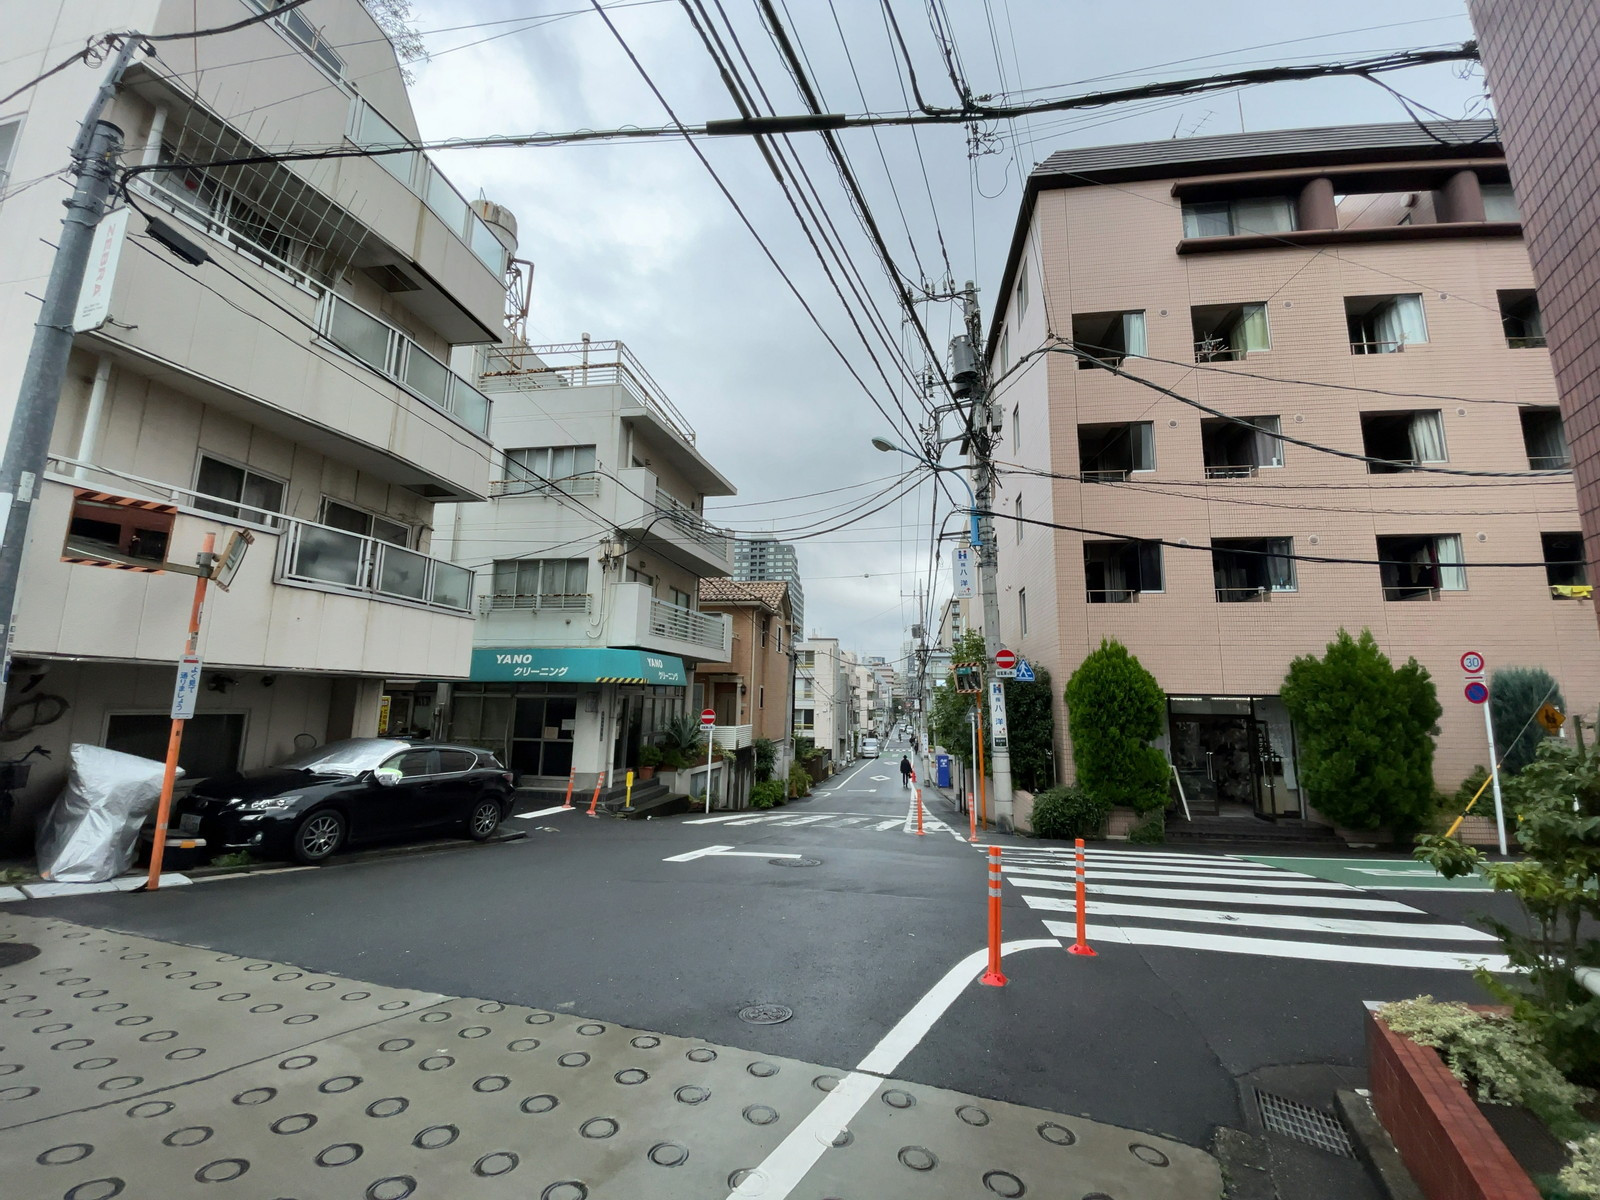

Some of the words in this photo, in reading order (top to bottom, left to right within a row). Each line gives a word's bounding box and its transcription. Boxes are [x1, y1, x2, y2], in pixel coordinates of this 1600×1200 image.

[496, 654, 532, 664] YANO
[646, 657, 663, 668] YANO
[1466, 657, 1479, 668] 30
[513, 666, 568, 677] クリーニング
[658, 671, 679, 681] クリーニング
[188, 666, 198, 694] よく見て
[176, 671, 188, 711] 通りましょう
